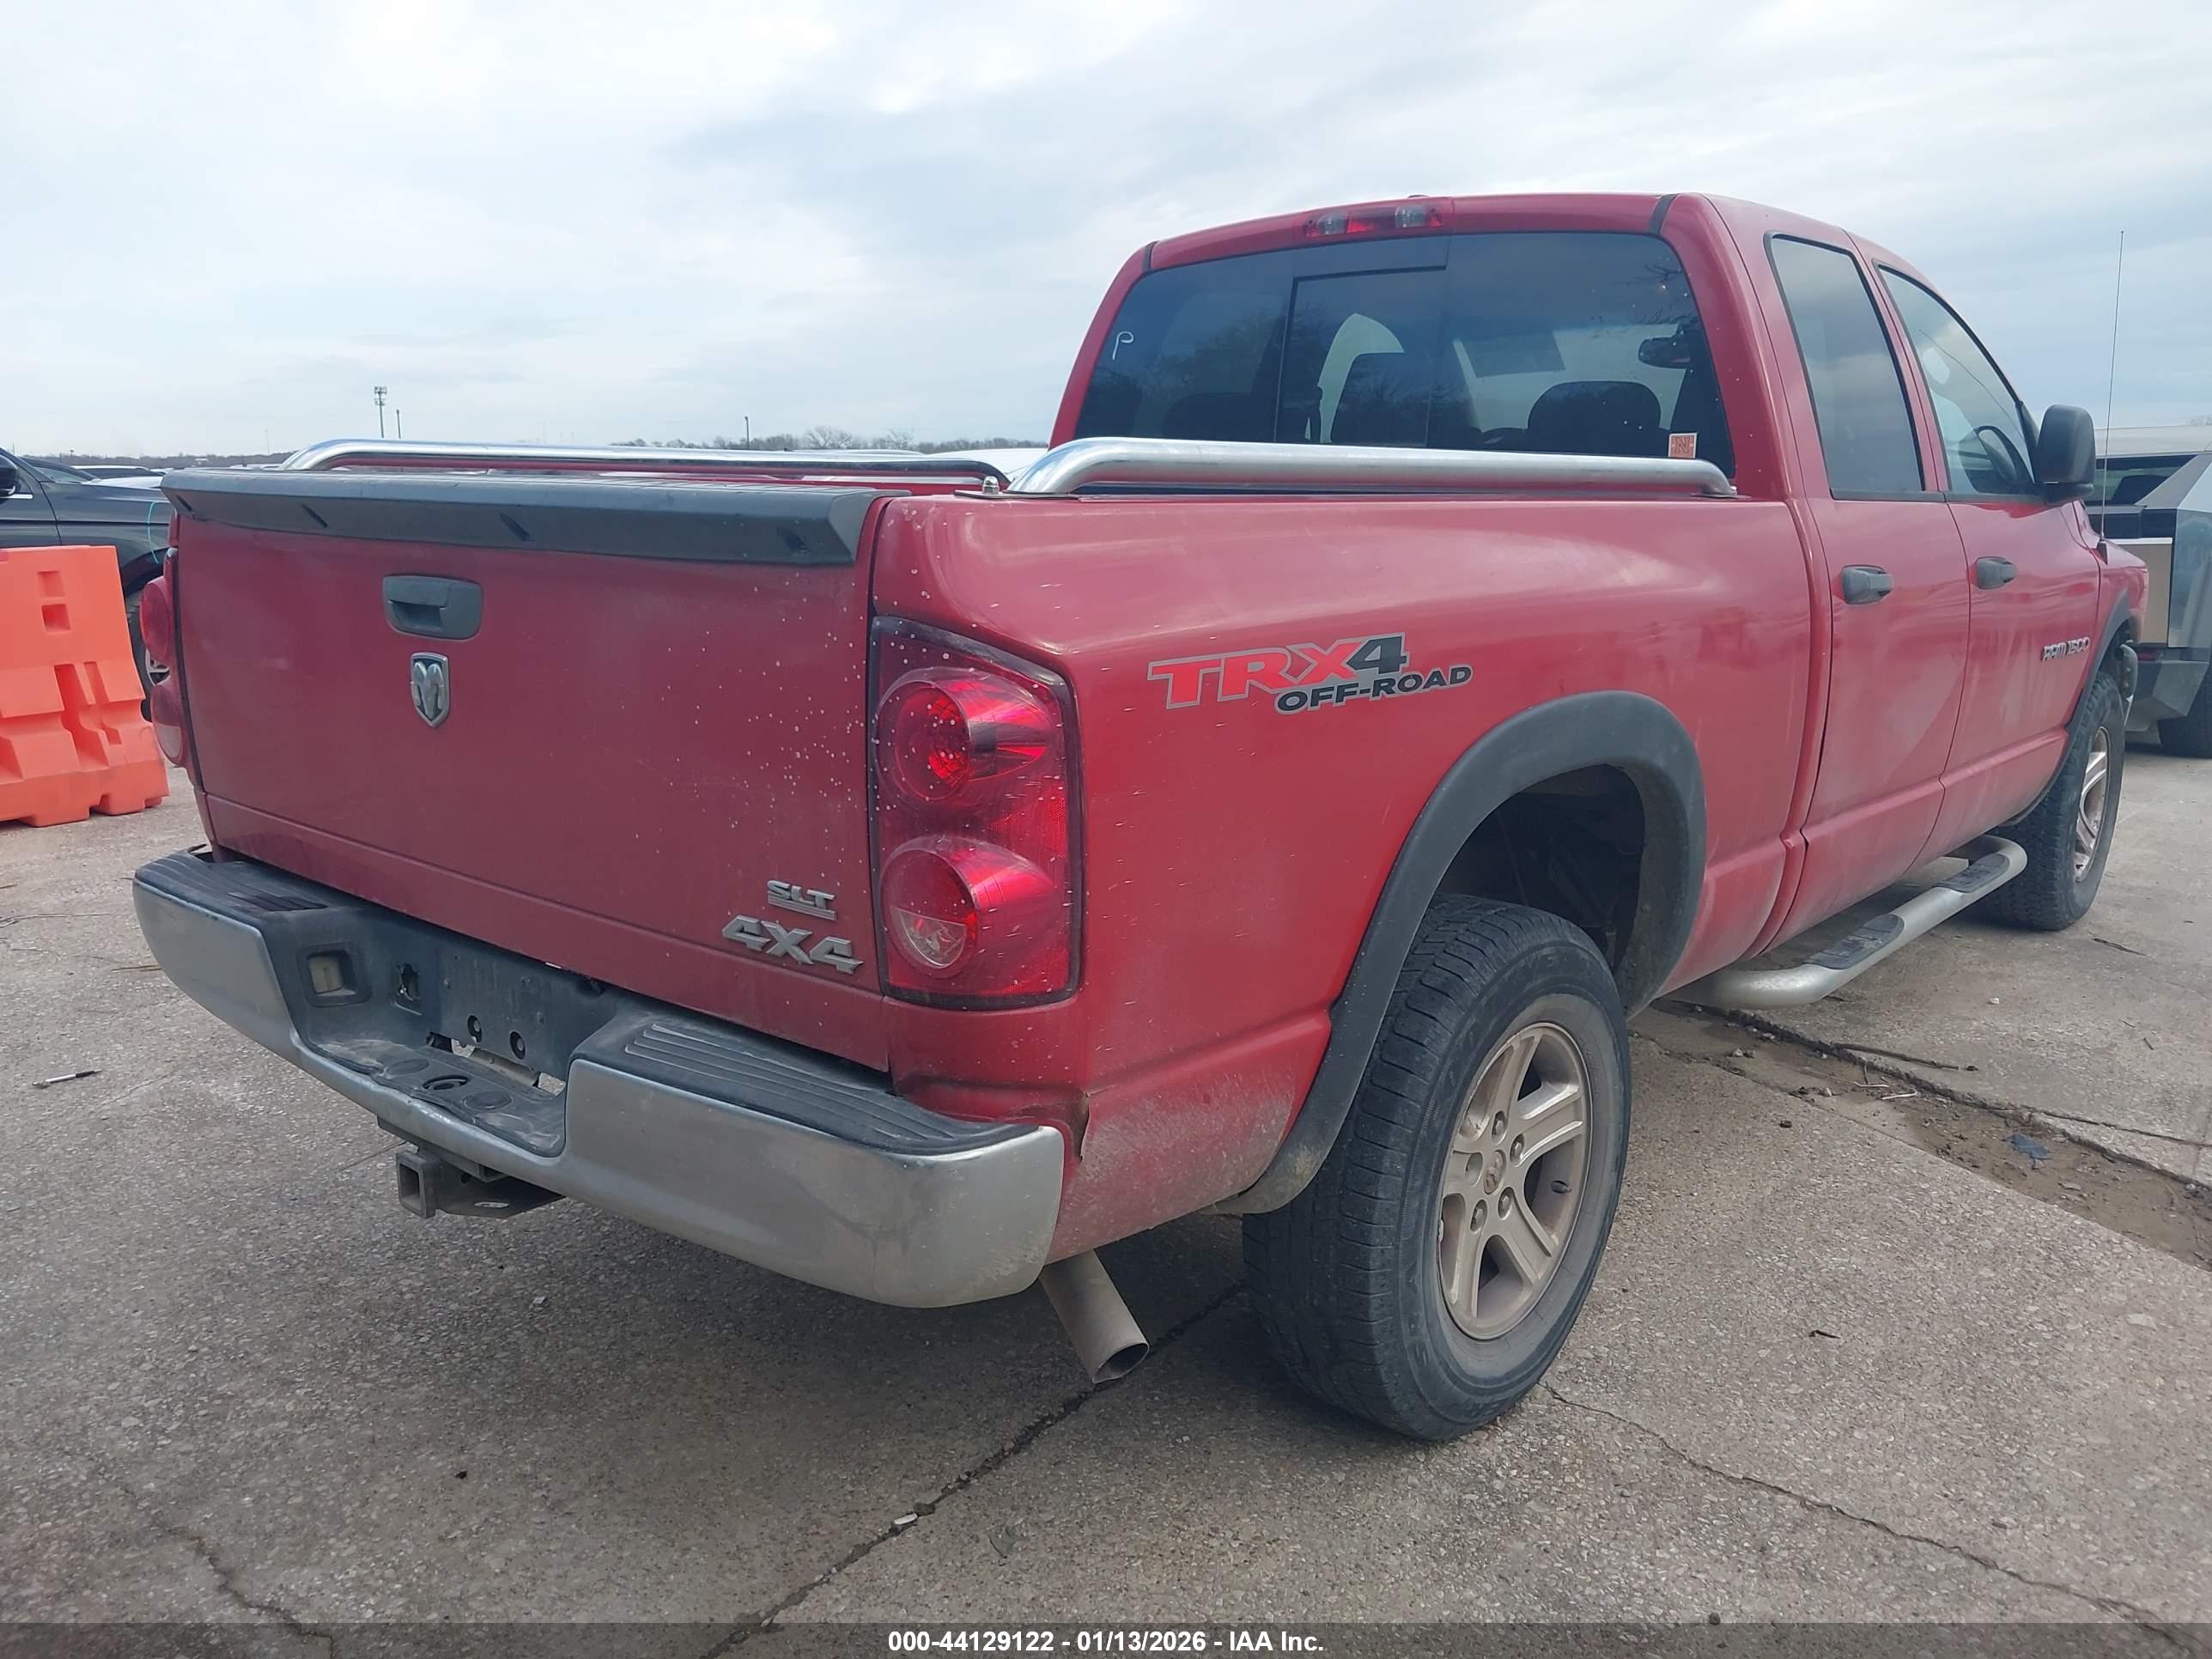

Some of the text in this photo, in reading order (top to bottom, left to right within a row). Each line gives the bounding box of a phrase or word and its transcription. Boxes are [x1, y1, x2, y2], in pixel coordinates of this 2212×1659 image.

[1674, 436, 1691, 454] N
[1148, 633, 1409, 708] TRX4
[1275, 665, 1473, 713] OFF-ROAD
[767, 880, 836, 912] SLT
